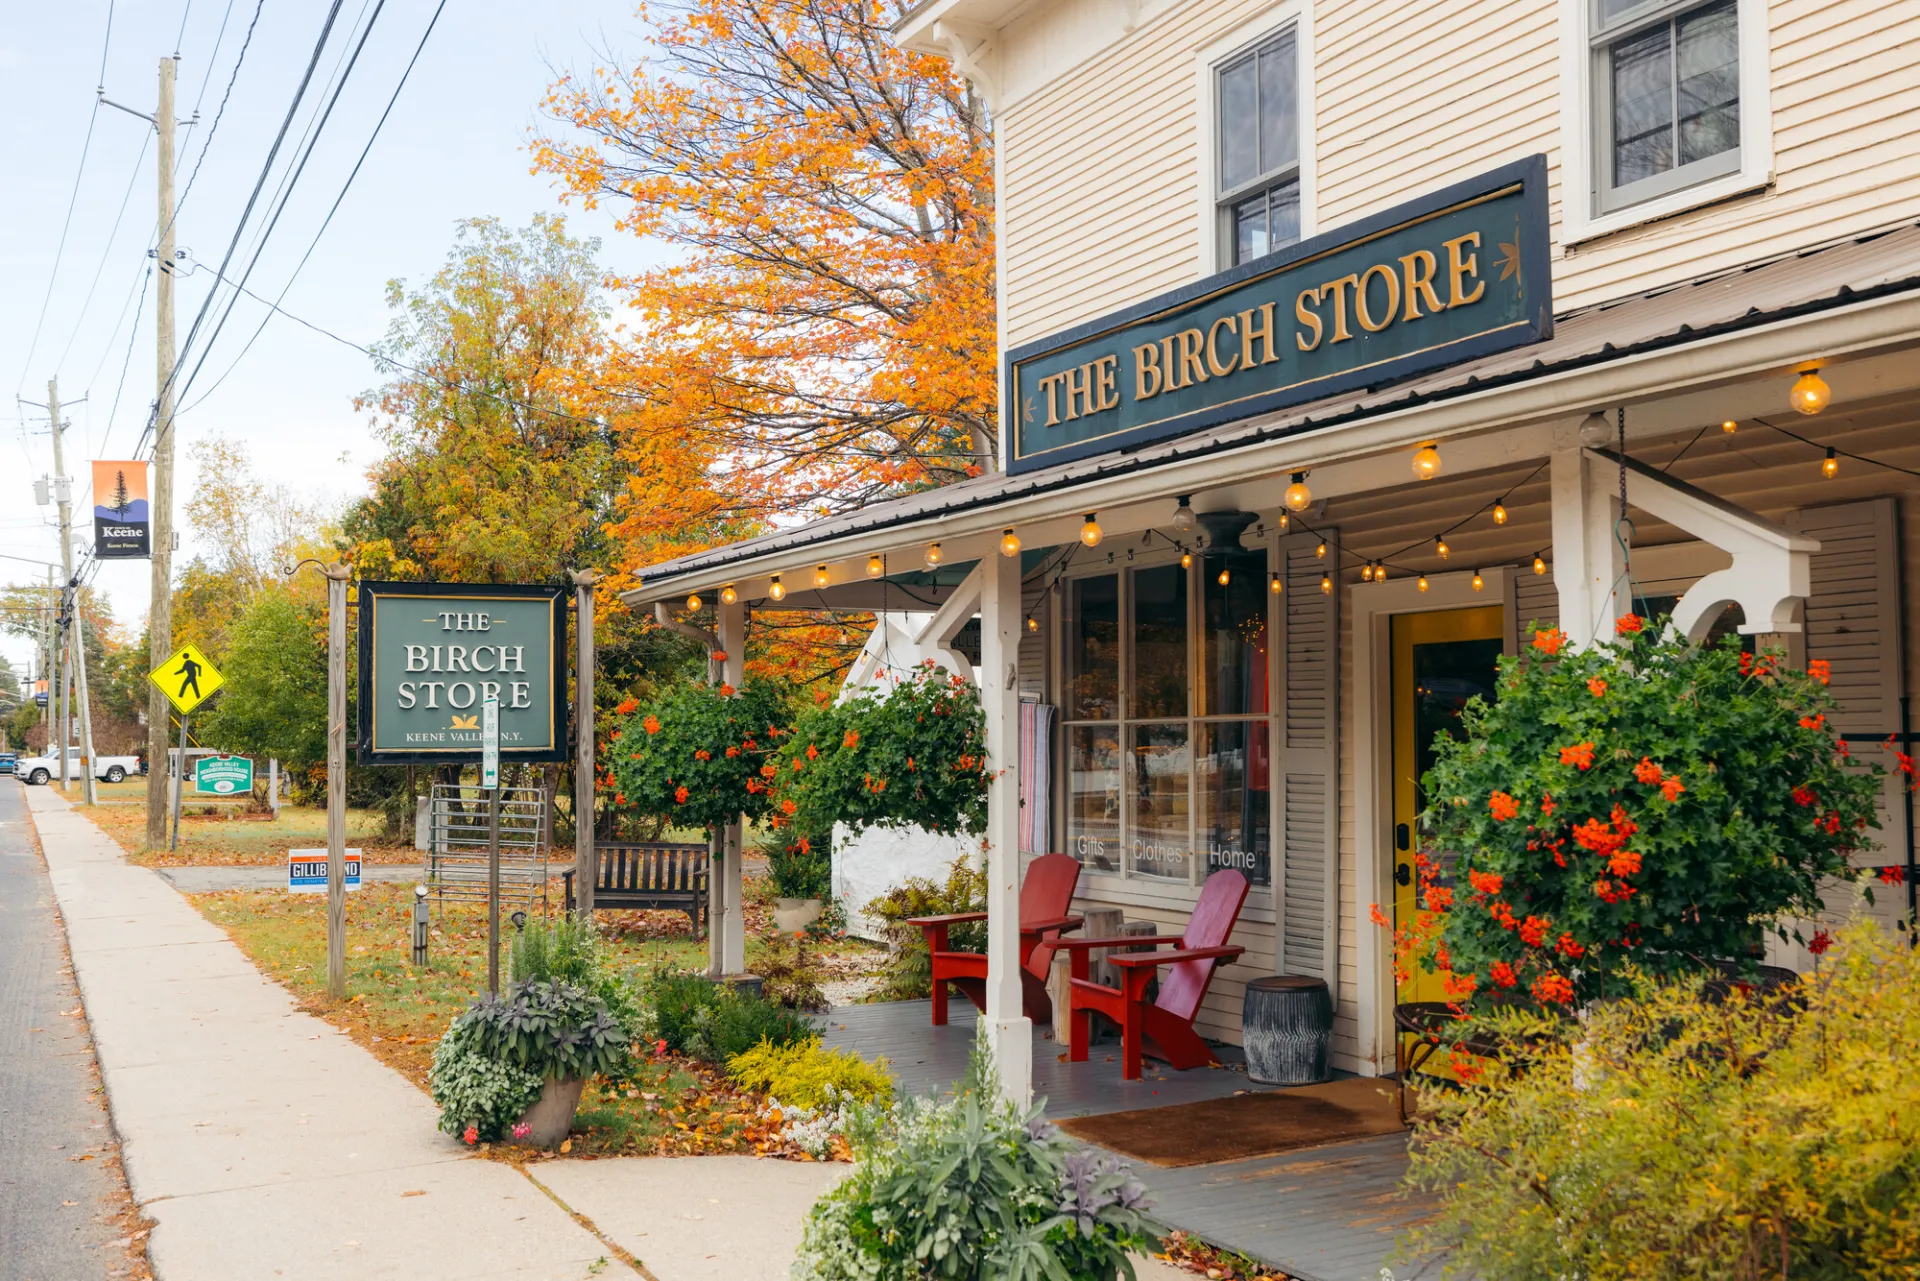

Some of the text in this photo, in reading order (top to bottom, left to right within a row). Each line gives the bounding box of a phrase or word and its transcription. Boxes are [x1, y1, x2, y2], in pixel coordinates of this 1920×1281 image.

[1038, 230, 1486, 427] THE BIRCH STORE
[102, 526, 143, 537] Keene
[439, 612, 491, 631] THE
[404, 644, 526, 673] BIRCH
[398, 681, 532, 710] STORE
[406, 732, 446, 742] KEENE
[450, 732, 484, 742] VALLE
[501, 732, 523, 741] N.Y.
[1077, 835, 1104, 856] Gifts
[1133, 839, 1183, 863] Clothes
[1210, 843, 1256, 869] Home
[293, 862, 358, 877] GILLIBND
